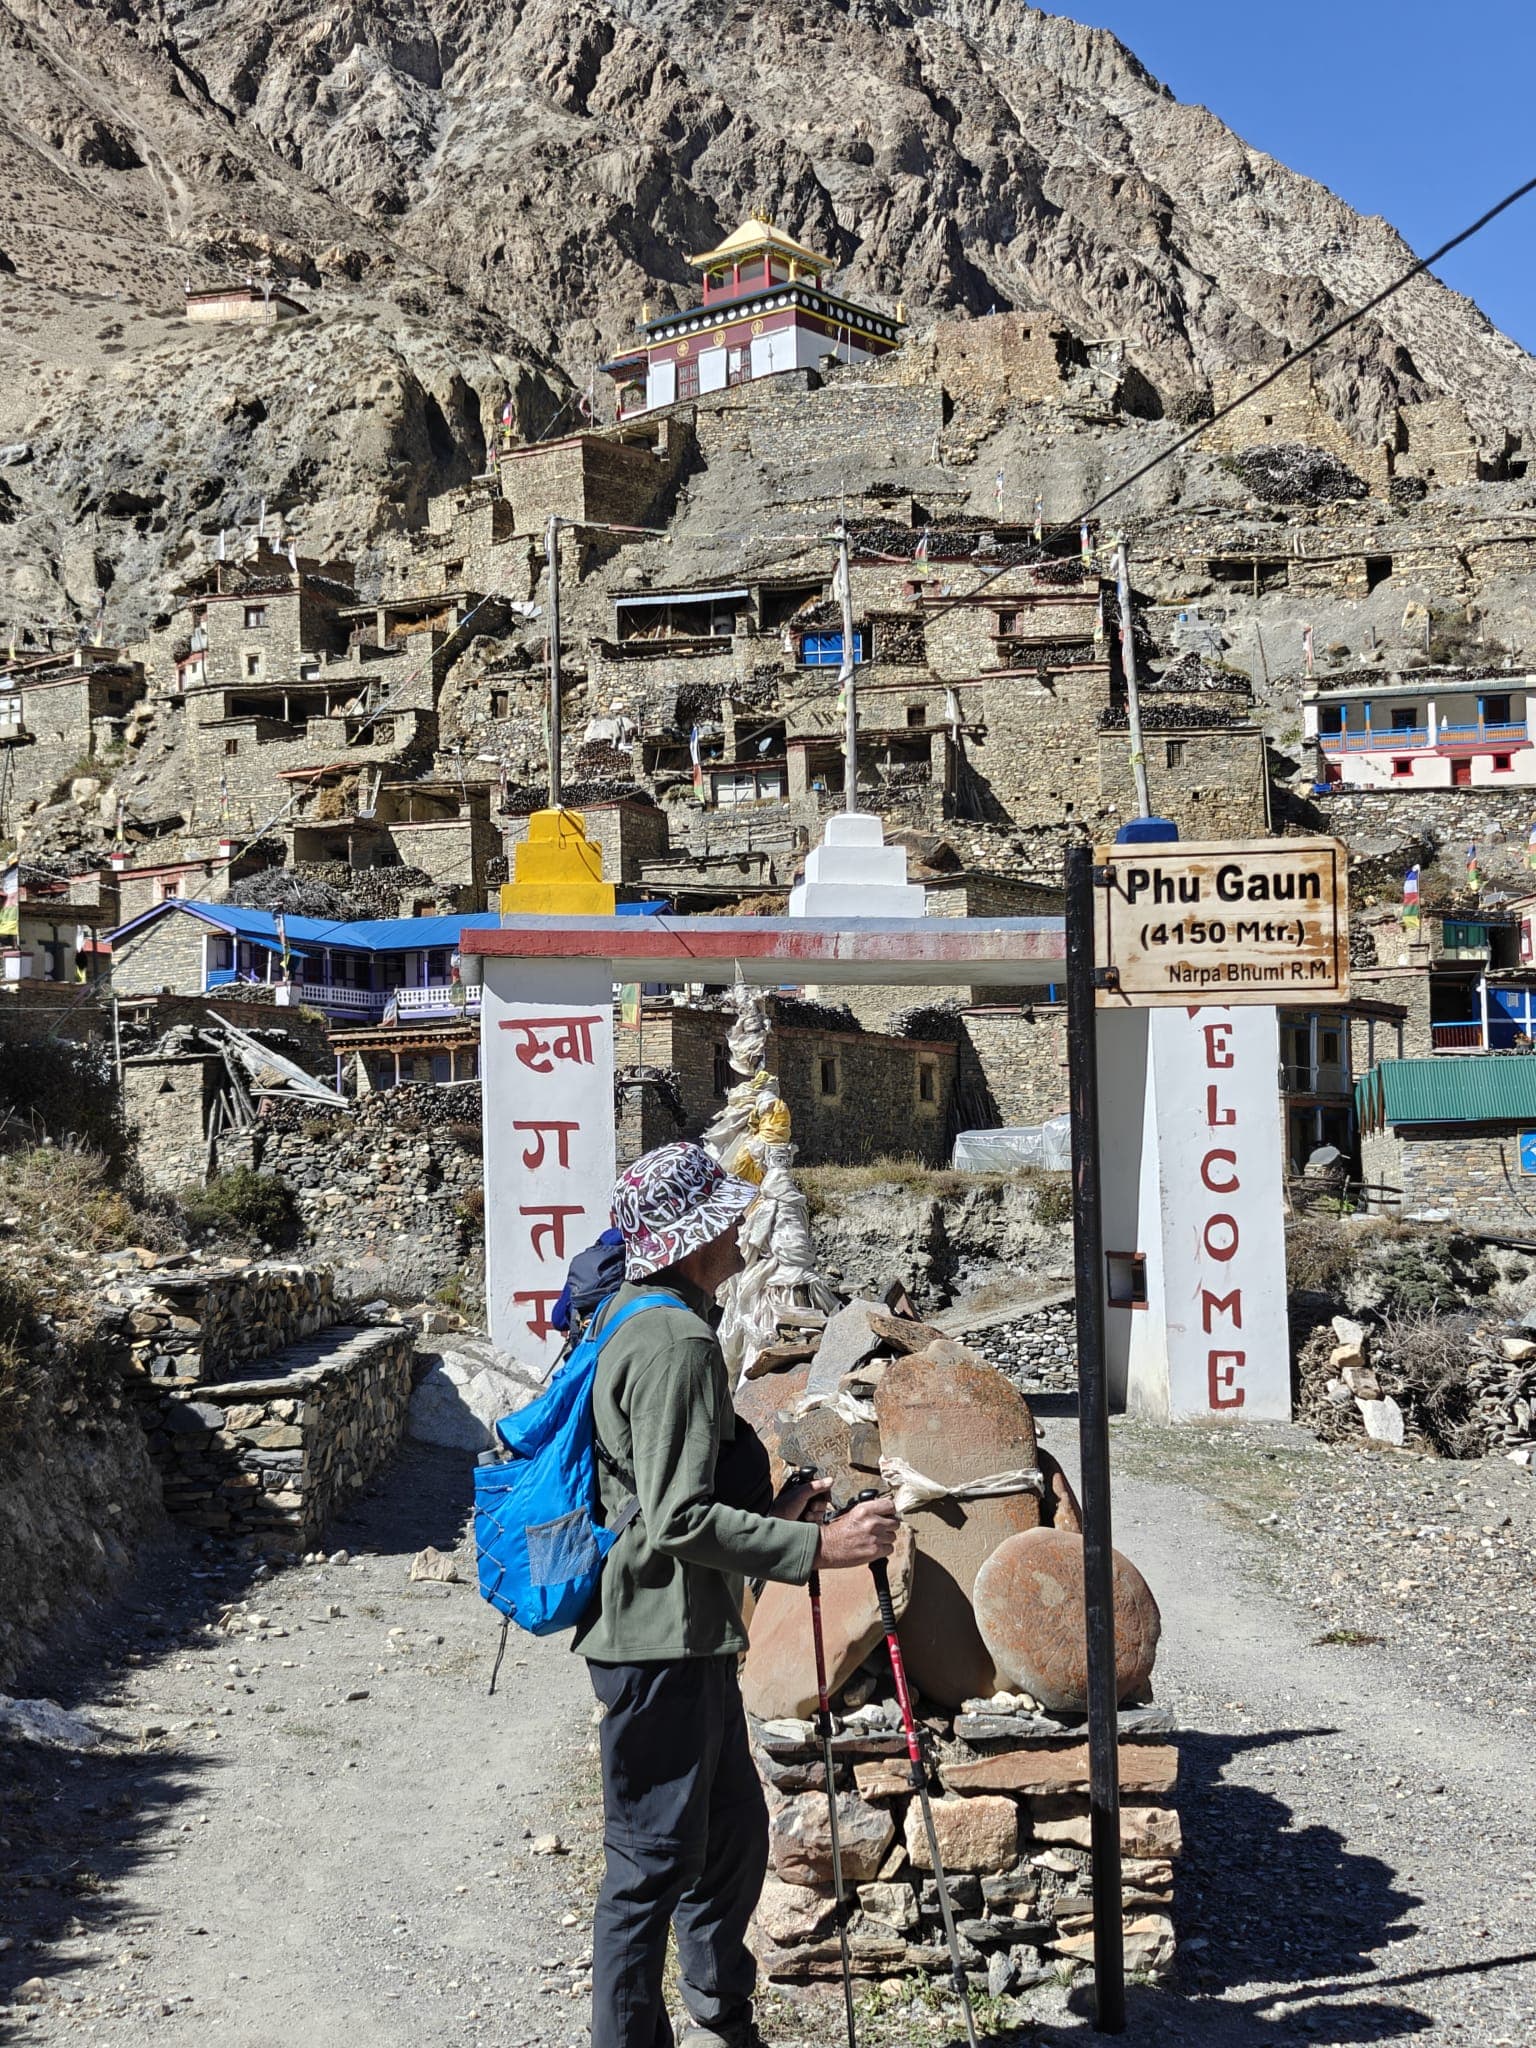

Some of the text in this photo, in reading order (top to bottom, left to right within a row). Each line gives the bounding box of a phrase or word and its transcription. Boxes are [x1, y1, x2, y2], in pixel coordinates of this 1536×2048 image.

[1126, 864, 1321, 905] Phu Gaun
[1140, 919, 1305, 951] (4150 Mtr.)
[1169, 960, 1332, 986] Narpa Bhumi R.M.
[1186, 1005, 1245, 1410] ELCOME
